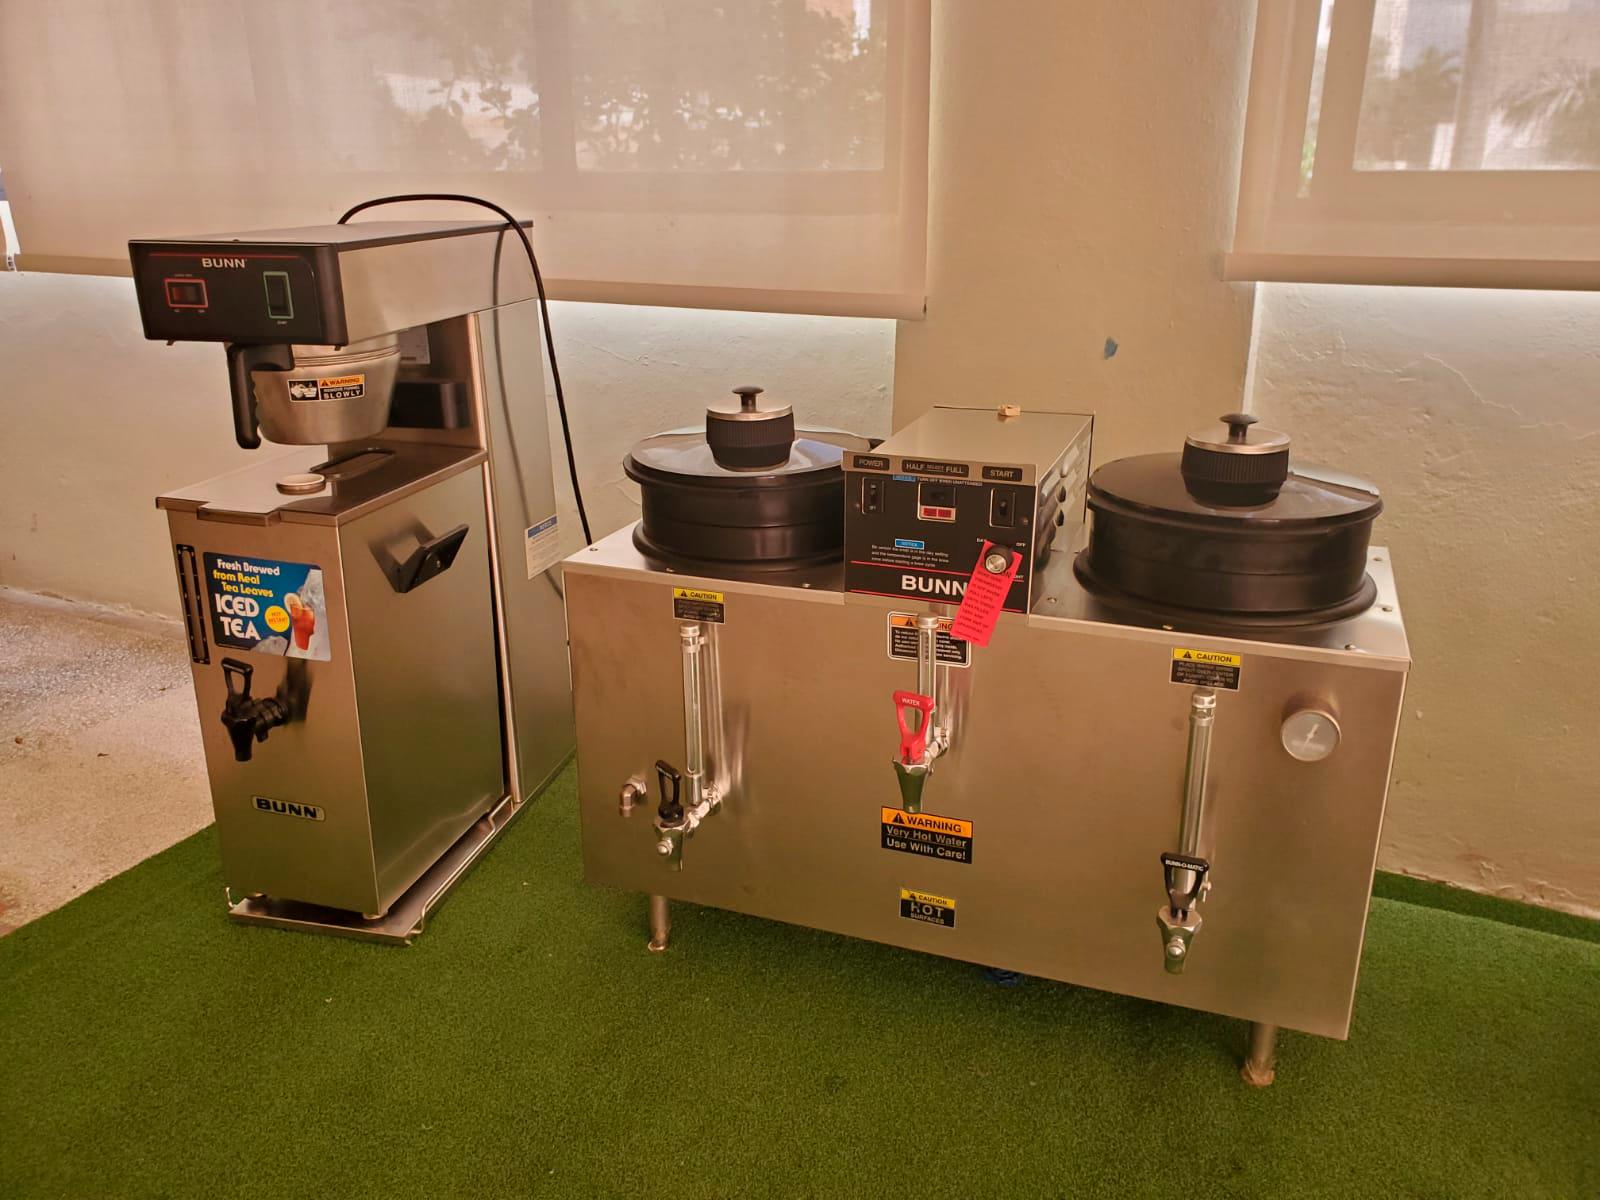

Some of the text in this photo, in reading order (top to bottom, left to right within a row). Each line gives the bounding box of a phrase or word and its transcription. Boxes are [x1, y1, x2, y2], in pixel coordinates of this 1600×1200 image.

[202, 258, 245, 268] BUNN
[330, 378, 360, 386] WARNING
[859, 458, 884, 468] POWER
[906, 463, 924, 472] HALF
[946, 466, 964, 474] FULL
[990, 470, 1014, 478] START
[217, 559, 280, 576] Fresh Brewed
[212, 570, 260, 584] from Real
[222, 582, 274, 598] Tea Leaves
[902, 574, 968, 596] BUNN
[690, 592, 718, 600] CAUTION
[215, 593, 260, 618] ICED
[220, 616, 262, 640] TEA
[1196, 654, 1232, 662] CAUTION
[901, 697, 920, 706] WATER
[256, 798, 317, 818] BUNN
[907, 816, 962, 832] WARNING
[886, 825, 967, 848] Very Hot Water
[886, 838, 966, 860] Use With Care!
[918, 894, 948, 906] CAUTION
[910, 902, 944, 918] HOT
